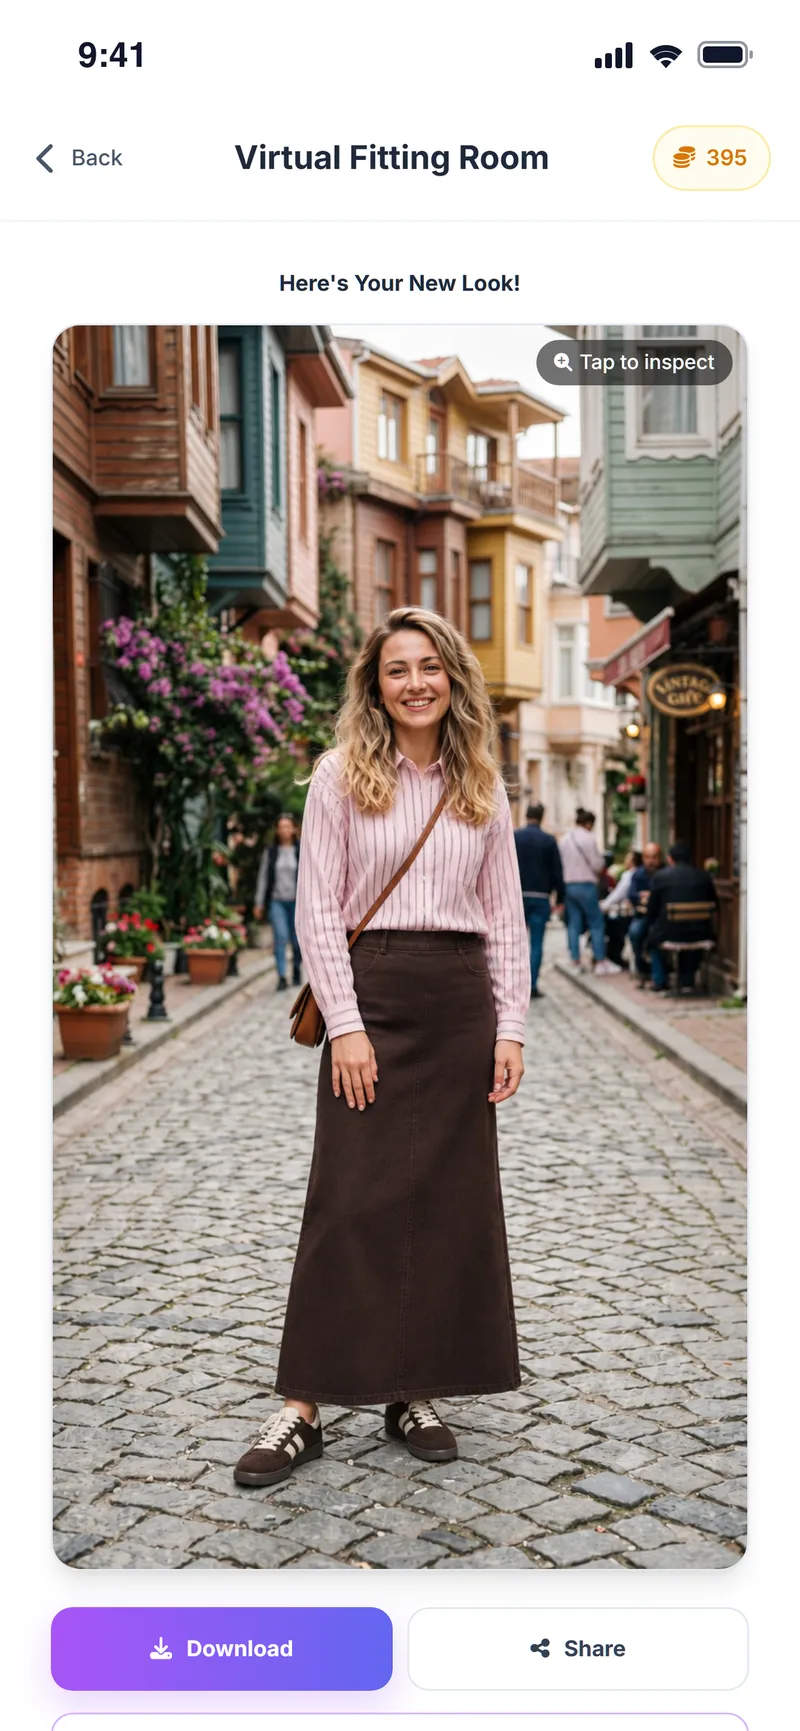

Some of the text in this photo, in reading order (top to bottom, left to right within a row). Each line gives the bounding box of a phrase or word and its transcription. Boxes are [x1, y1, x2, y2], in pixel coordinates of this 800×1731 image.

[78, 42, 143, 69] 9:41
[72, 148, 123, 167] Back
[235, 143, 549, 177] Virtual Fitting Room
[706, 148, 747, 167] 395
[279, 274, 520, 292] Here's Your New Look!
[580, 353, 715, 374] Tap to inspect
[655, 675, 714, 695] VINTAG
[187, 1639, 293, 1658] Download
[564, 1639, 626, 1658] Share
